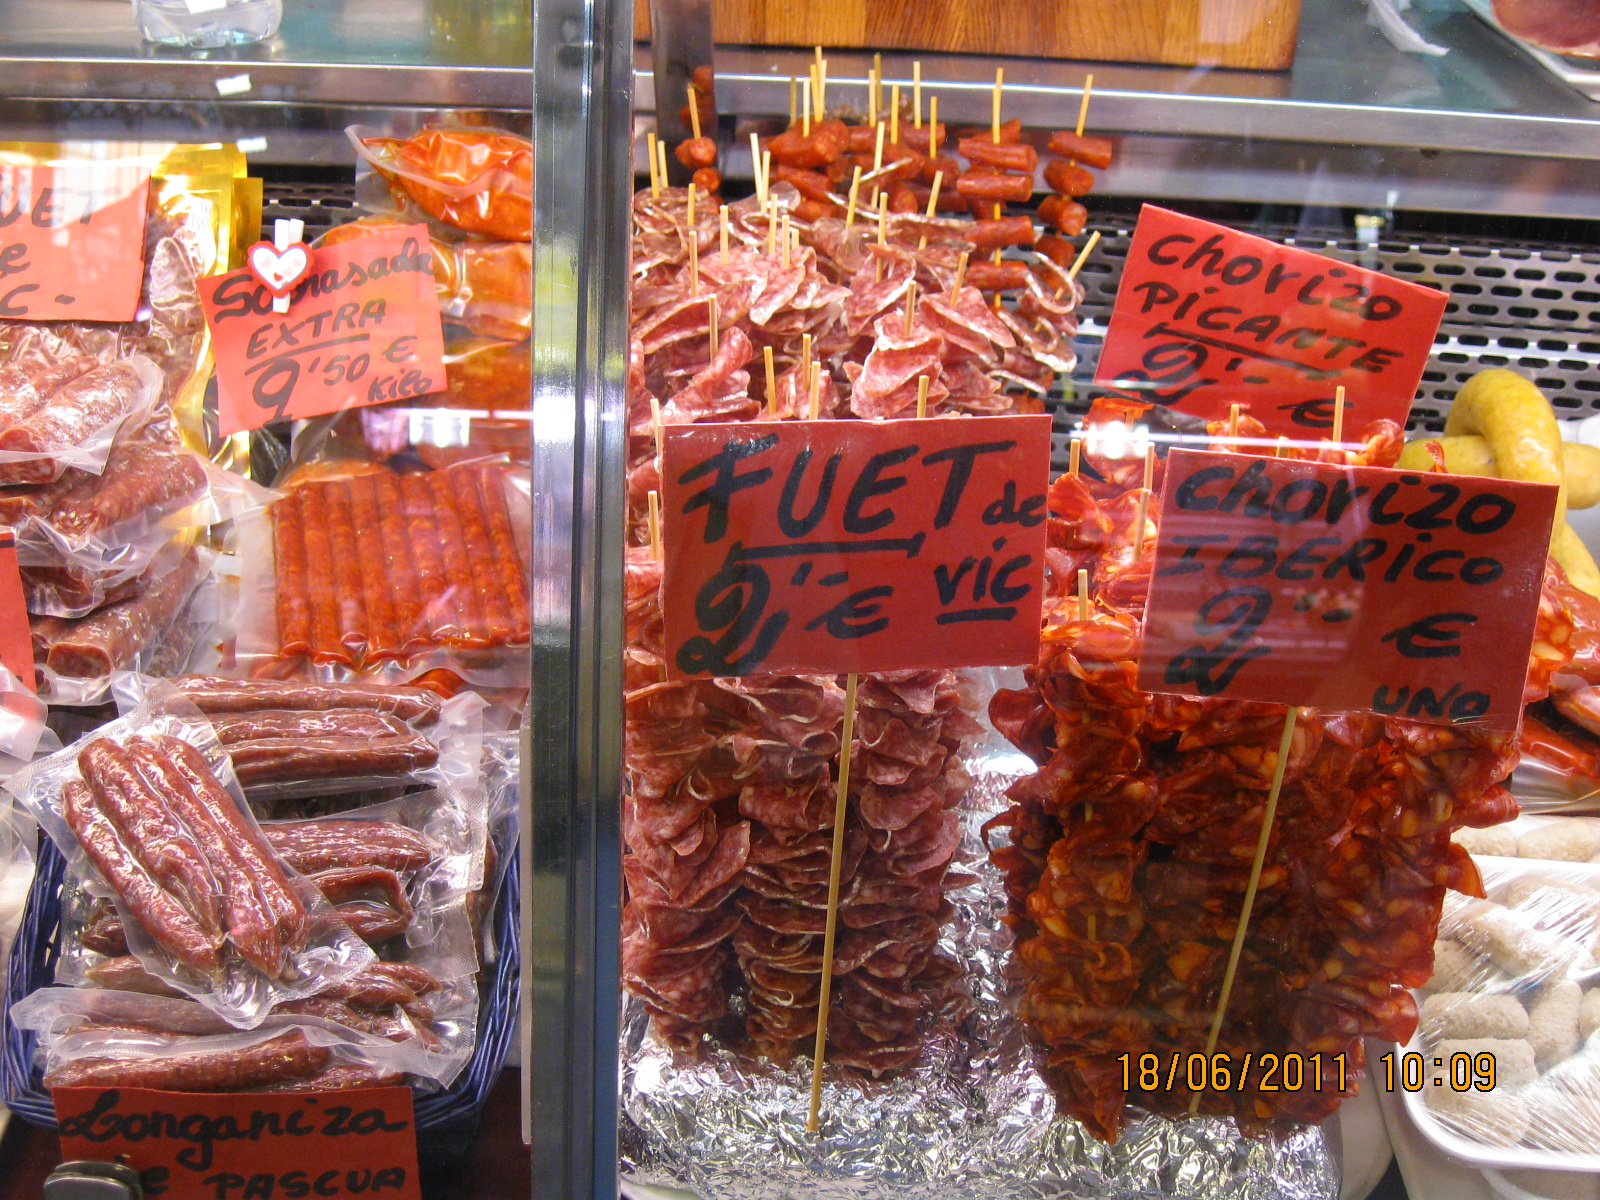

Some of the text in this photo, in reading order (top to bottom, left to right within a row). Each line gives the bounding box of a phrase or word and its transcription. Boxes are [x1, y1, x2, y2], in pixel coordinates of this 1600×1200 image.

[0, 184, 122, 228] UET
[247, 298, 386, 358] EXTRA
[677, 433, 1047, 543] FUET de
[1372, 683, 1490, 721] UNO
[57, 1089, 409, 1171] Longaniza
[203, 1166, 406, 1200] PASCUA
